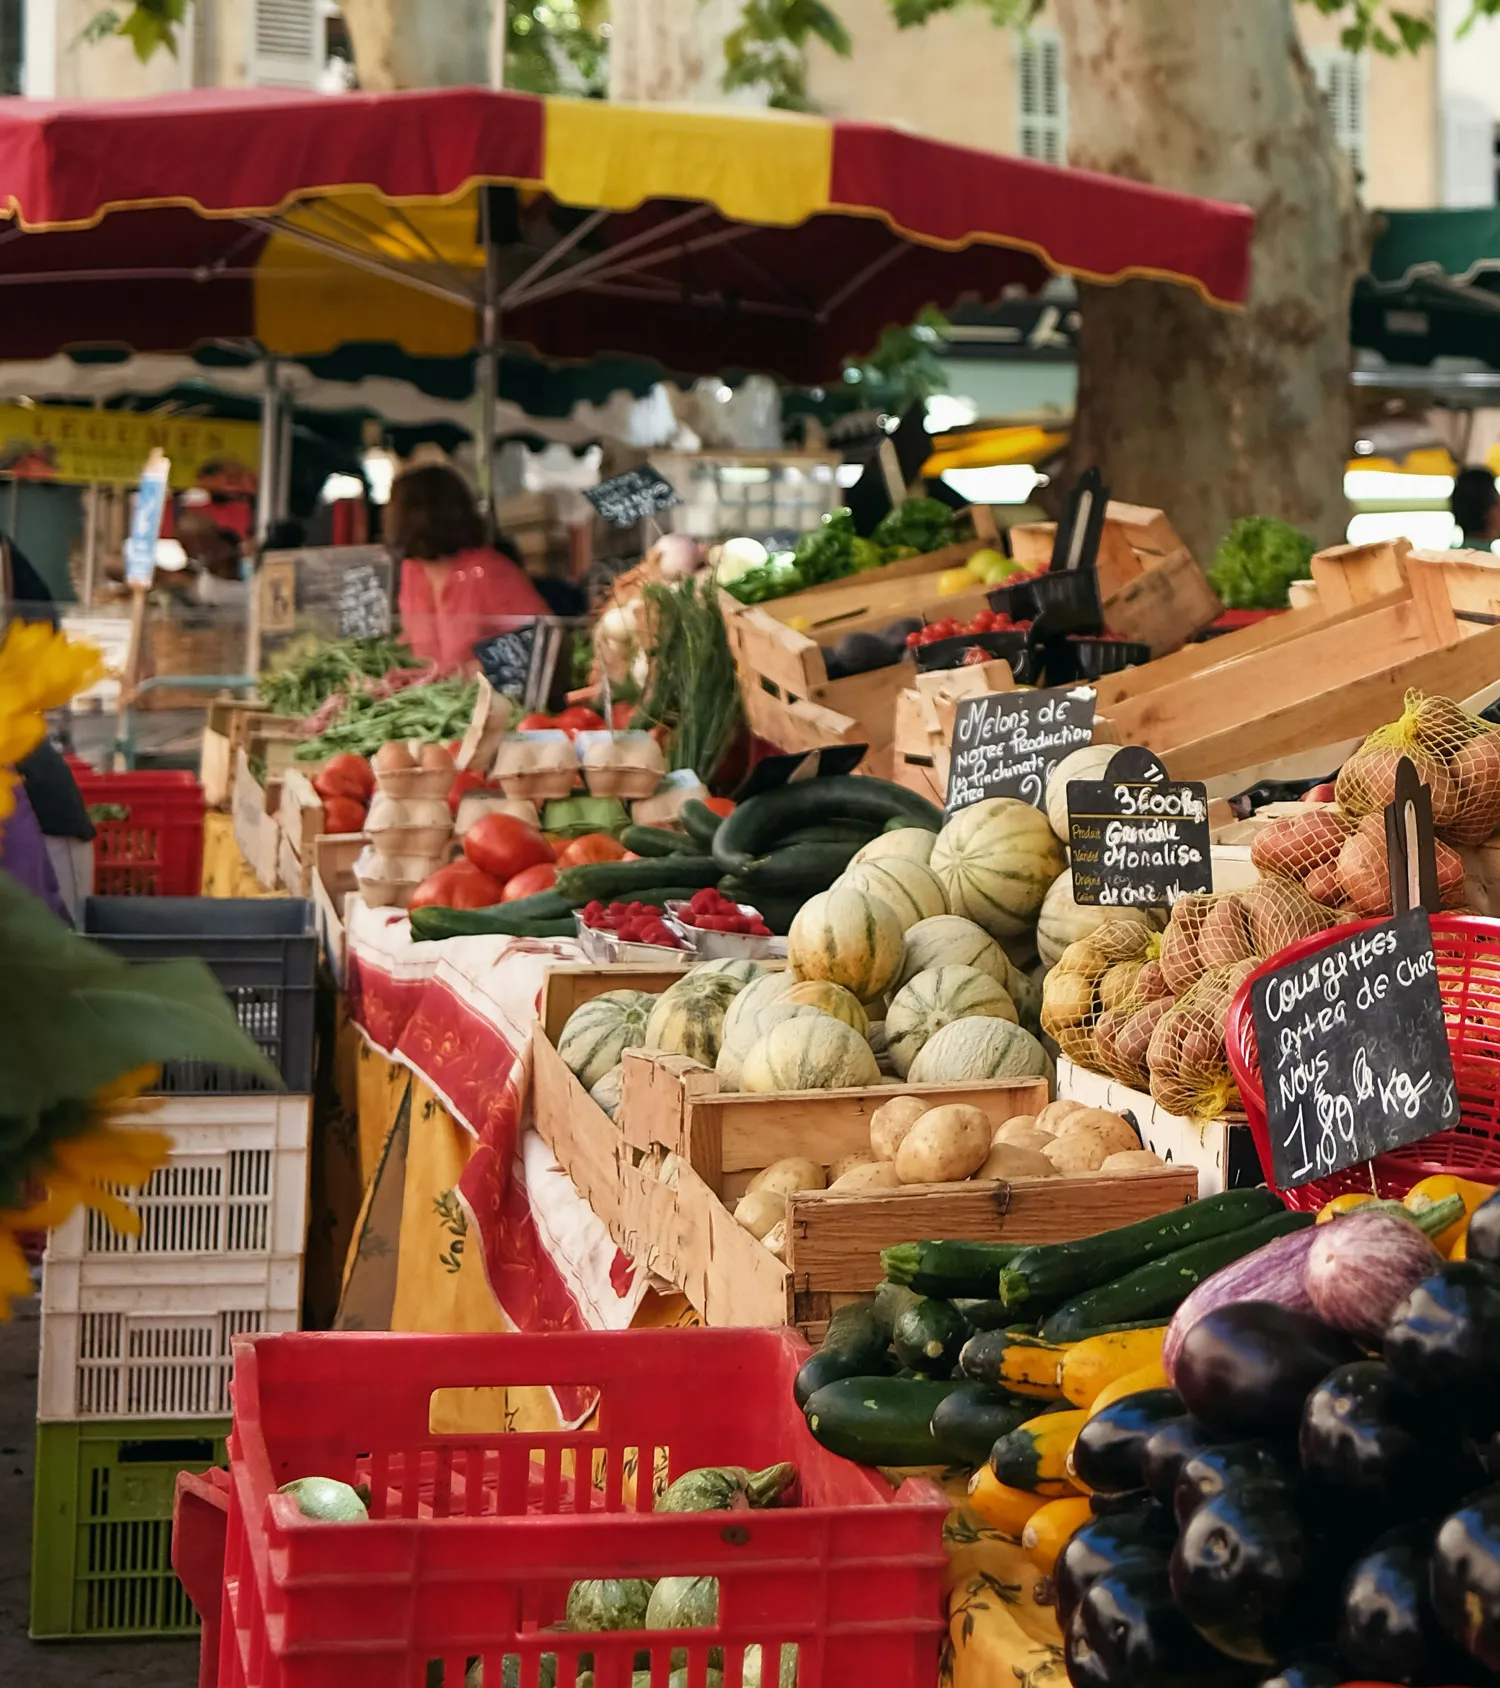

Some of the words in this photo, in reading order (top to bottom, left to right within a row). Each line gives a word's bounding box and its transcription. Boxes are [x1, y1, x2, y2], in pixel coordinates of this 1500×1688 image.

[959, 699, 1030, 746] Melons
[1103, 844, 1203, 870] Monalisa
[1265, 929, 1397, 1022] Courgettes
